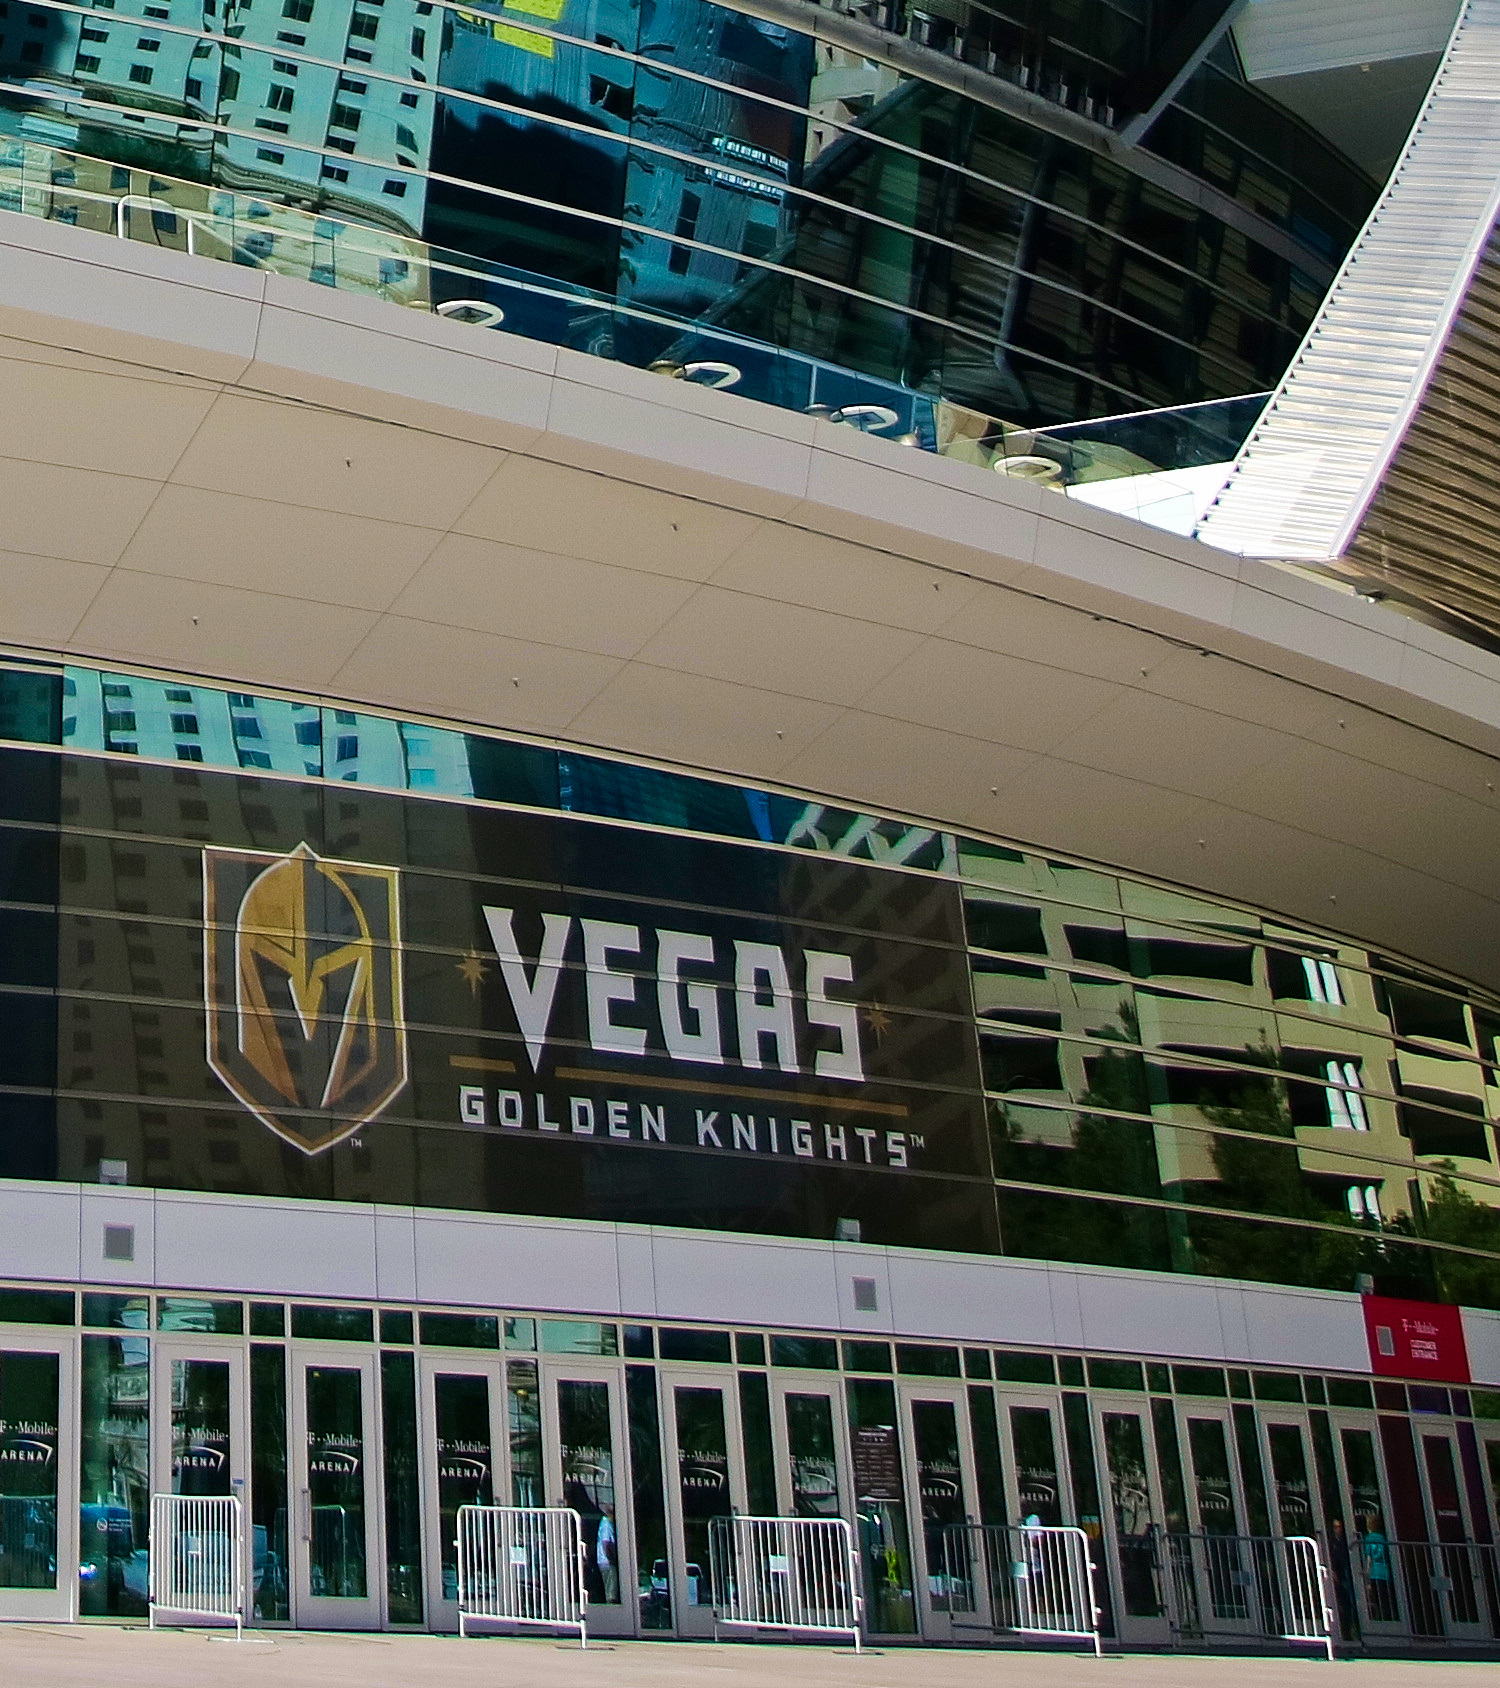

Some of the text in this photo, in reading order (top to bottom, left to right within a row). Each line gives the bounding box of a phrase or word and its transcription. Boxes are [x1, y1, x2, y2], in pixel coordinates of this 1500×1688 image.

[481, 904, 866, 1083] VEGAS
[459, 1084, 667, 1143] GOLDEN
[0, 1449, 44, 1461] ARENA
[174, 1455, 216, 1468] ARENA
[310, 1460, 351, 1472] ARENA
[440, 1466, 479, 1478] ARENA
